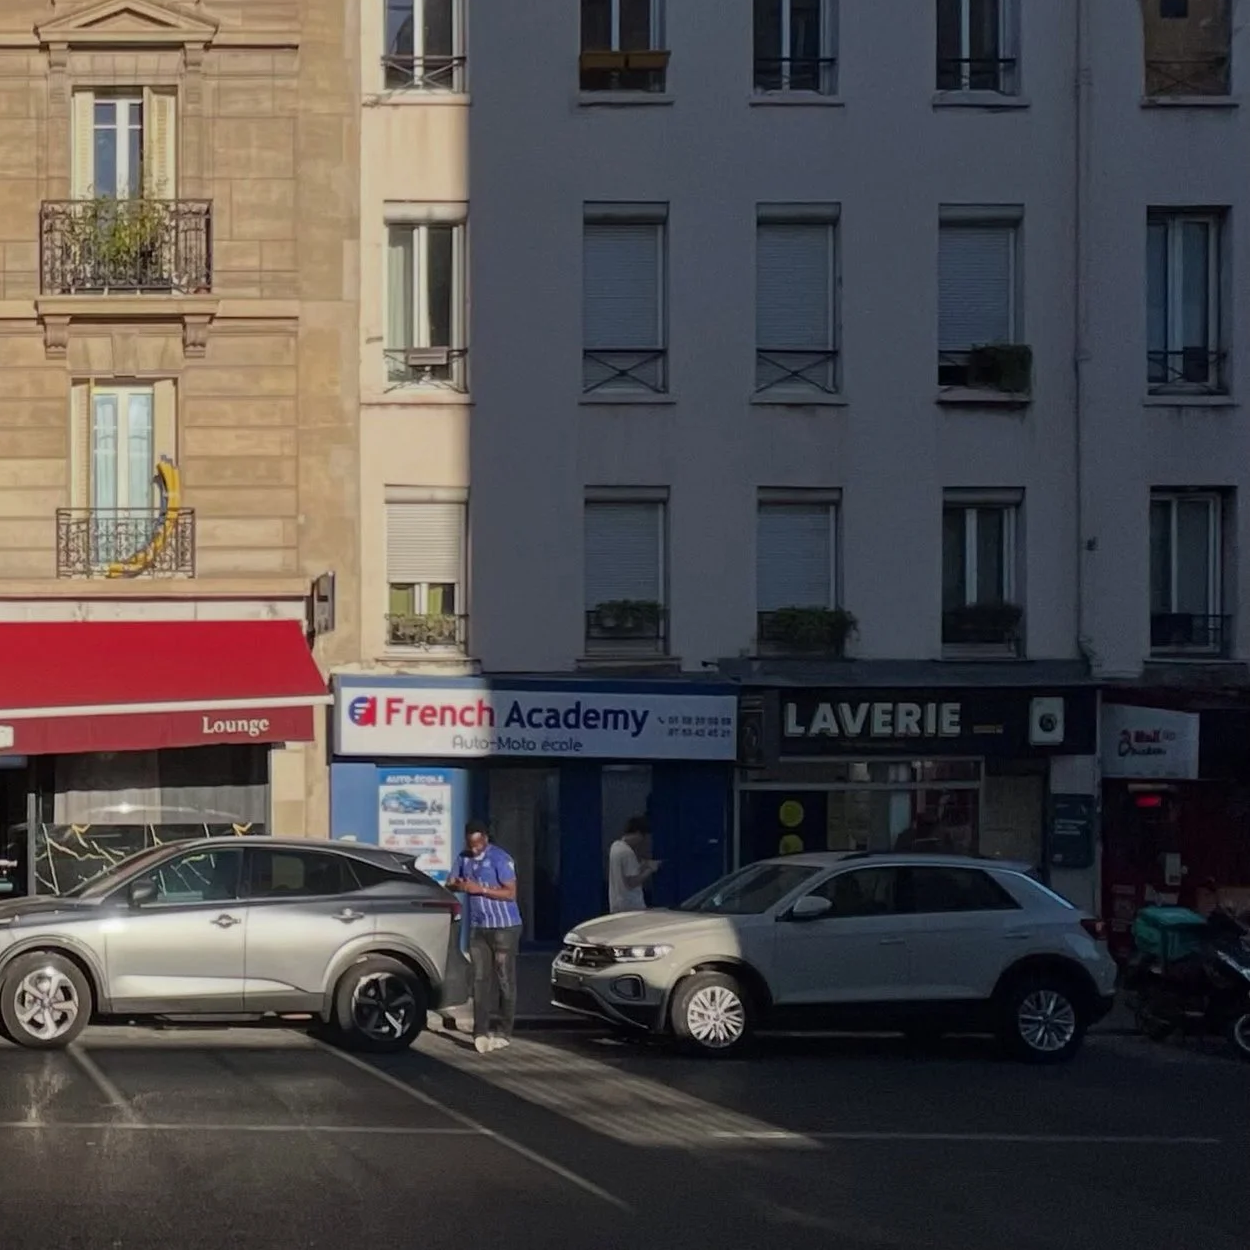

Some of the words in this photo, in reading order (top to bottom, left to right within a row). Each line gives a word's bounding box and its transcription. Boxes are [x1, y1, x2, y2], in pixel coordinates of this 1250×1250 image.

[202, 716, 270, 738] Lounge
[386, 697, 495, 727] French
[505, 700, 649, 737] Academy
[783, 702, 961, 737] LAVERIE
[452, 735, 536, 751] Auto-Moto
[541, 737, 583, 751] école
